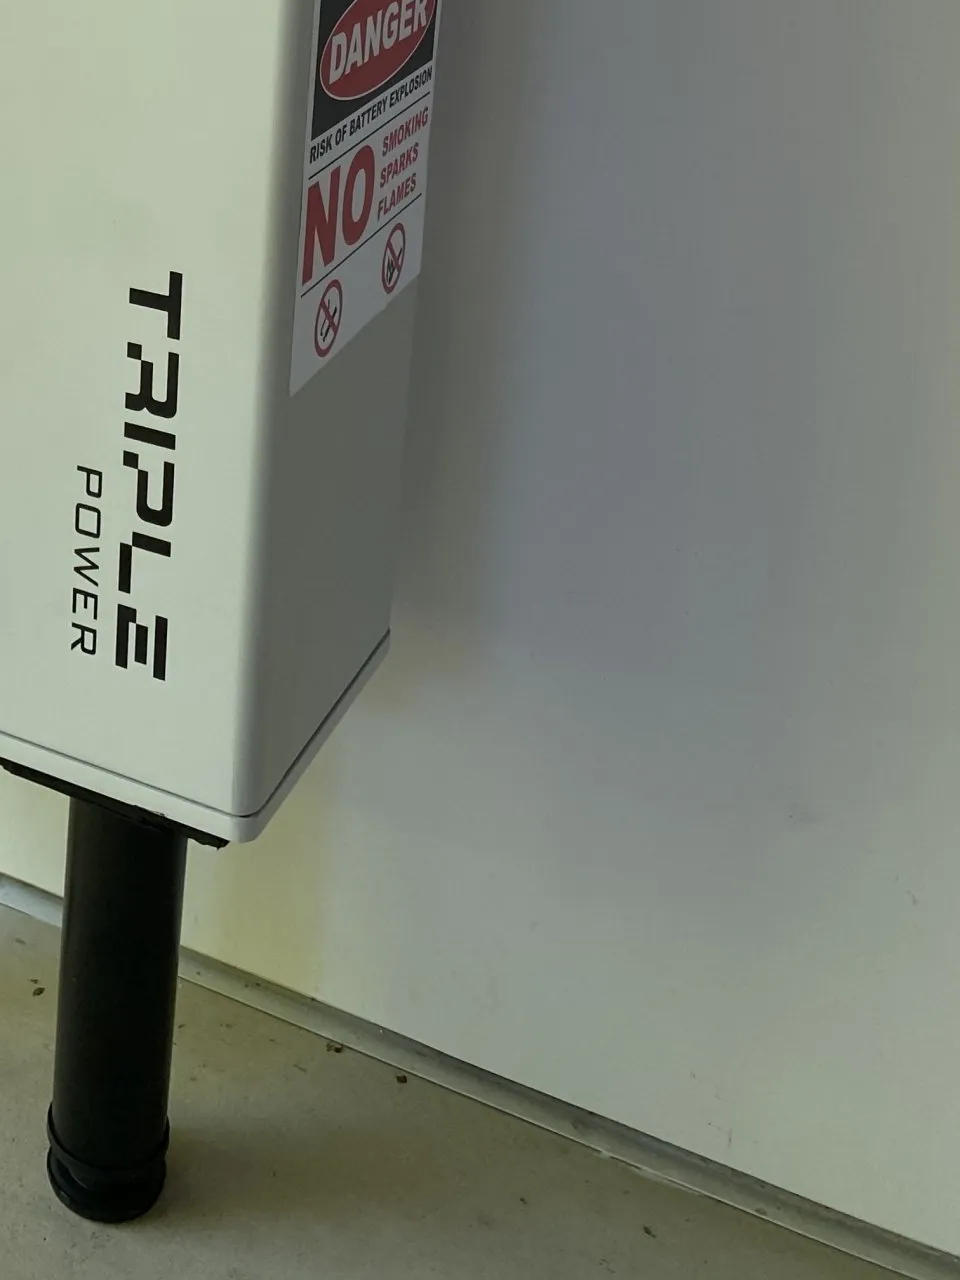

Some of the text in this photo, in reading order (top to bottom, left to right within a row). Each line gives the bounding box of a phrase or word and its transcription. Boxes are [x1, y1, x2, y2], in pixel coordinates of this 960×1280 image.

[309, 66, 432, 164] RISK OF BATTERY EXPLOSION
[382, 106, 429, 157] SMOKING
[377, 172, 417, 221] FLAMES
[380, 142, 419, 189] SPARKS
[302, 144, 375, 286] NO
[115, 271, 183, 681] TRIPLE
[71, 464, 103, 655] POWER
